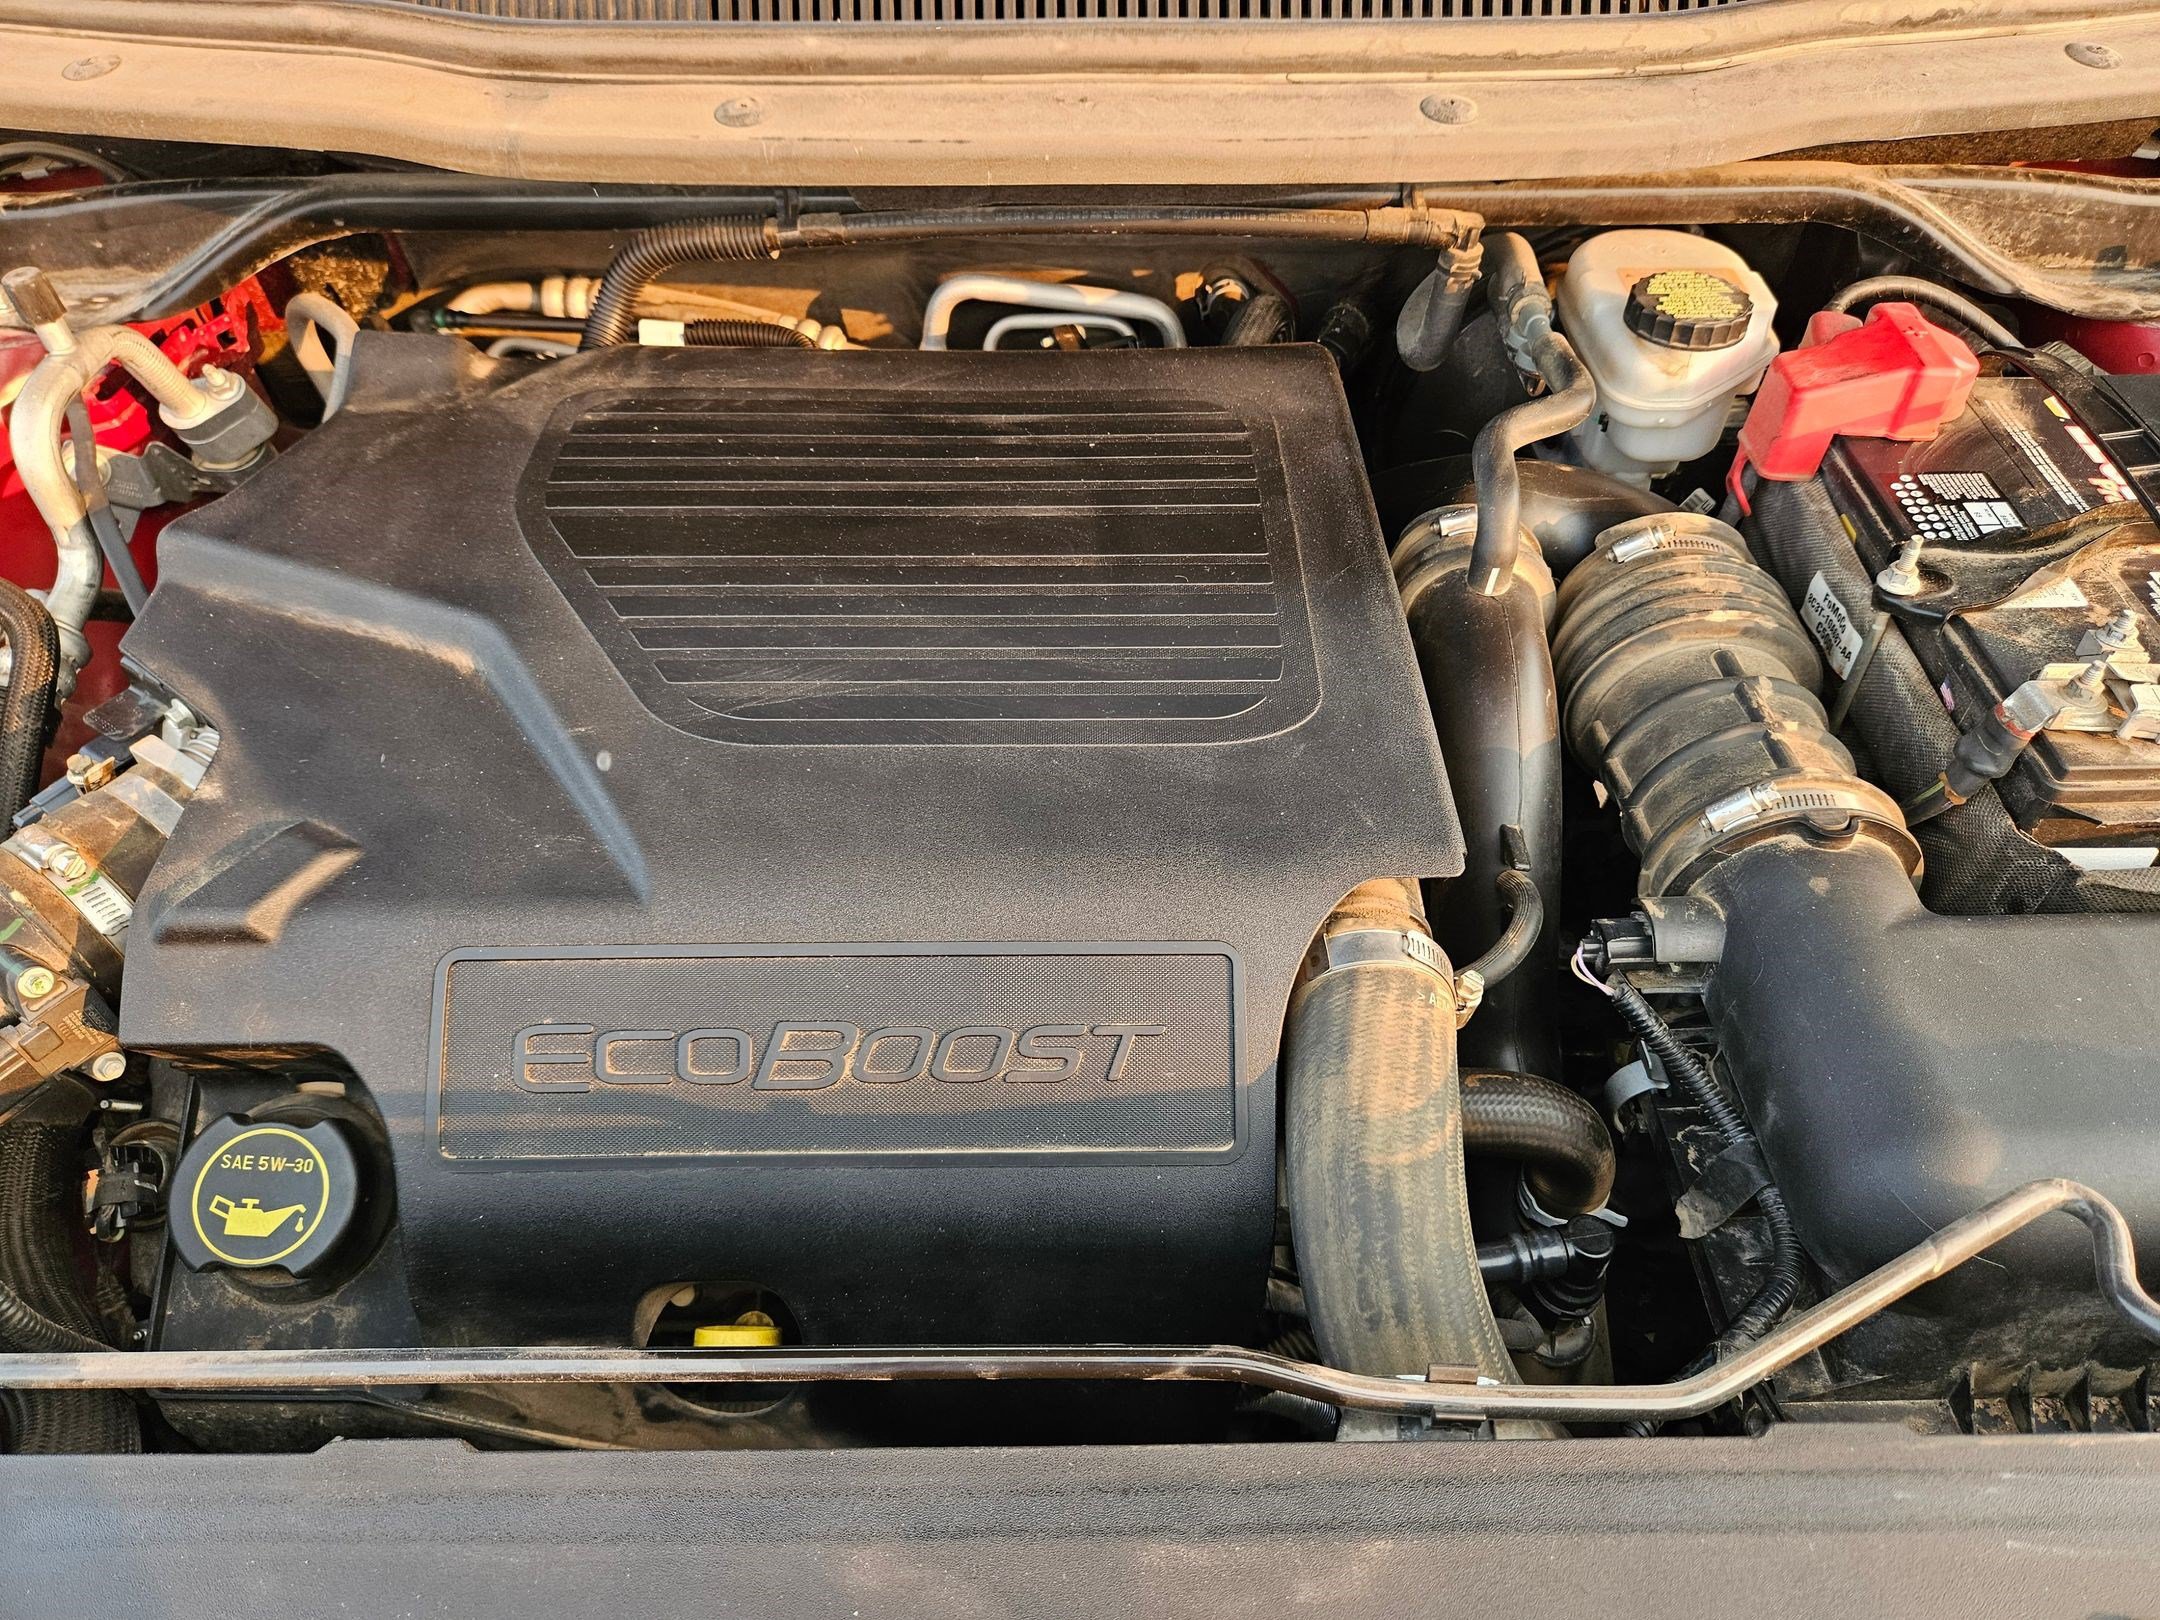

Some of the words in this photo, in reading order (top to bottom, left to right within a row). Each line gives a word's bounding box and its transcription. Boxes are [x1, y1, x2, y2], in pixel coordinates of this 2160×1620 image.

[1823, 593, 1847, 634] FoMoCo
[220, 1154, 255, 1170] SAE
[258, 1156, 314, 1173] 5W-30
